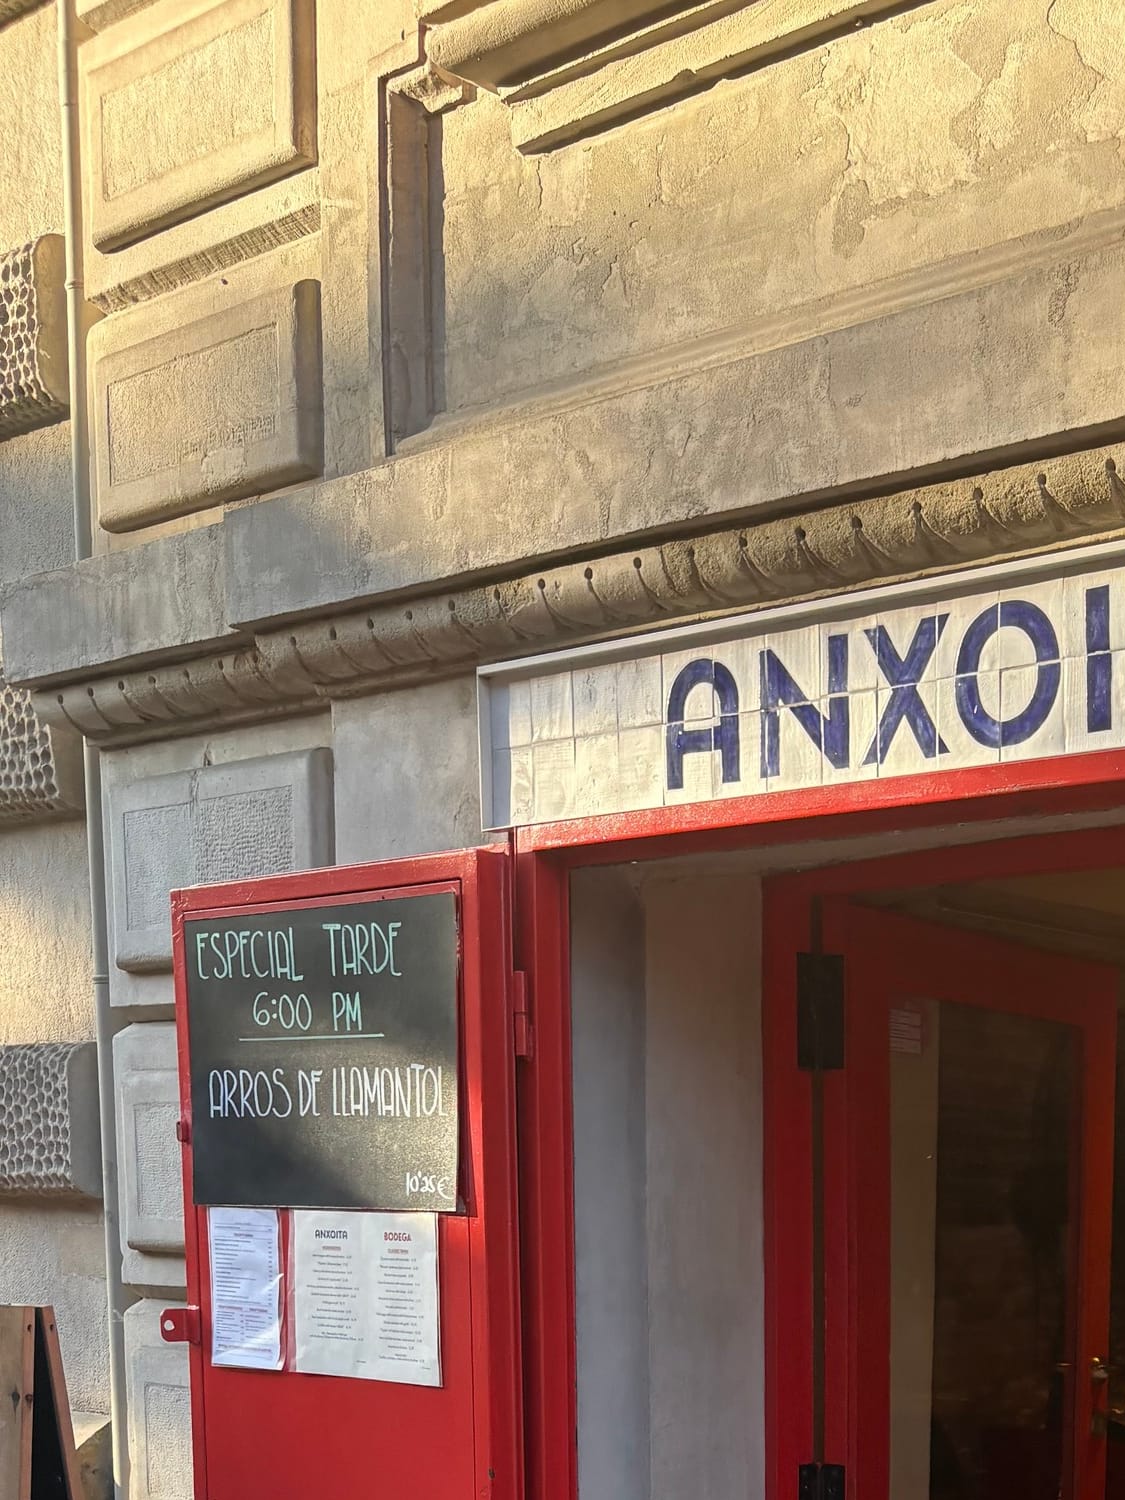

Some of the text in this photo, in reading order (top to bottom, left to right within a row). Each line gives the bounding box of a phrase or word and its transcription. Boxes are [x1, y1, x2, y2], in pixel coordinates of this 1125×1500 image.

[196, 921, 402, 981] ESPECIAL TARDE
[252, 991, 363, 1031] 6:00 PM
[208, 1063, 448, 1118] ARROS DE LLAMANTOL
[314, 1229, 348, 1240] ANXOITA
[383, 1231, 412, 1242] BODEGA
